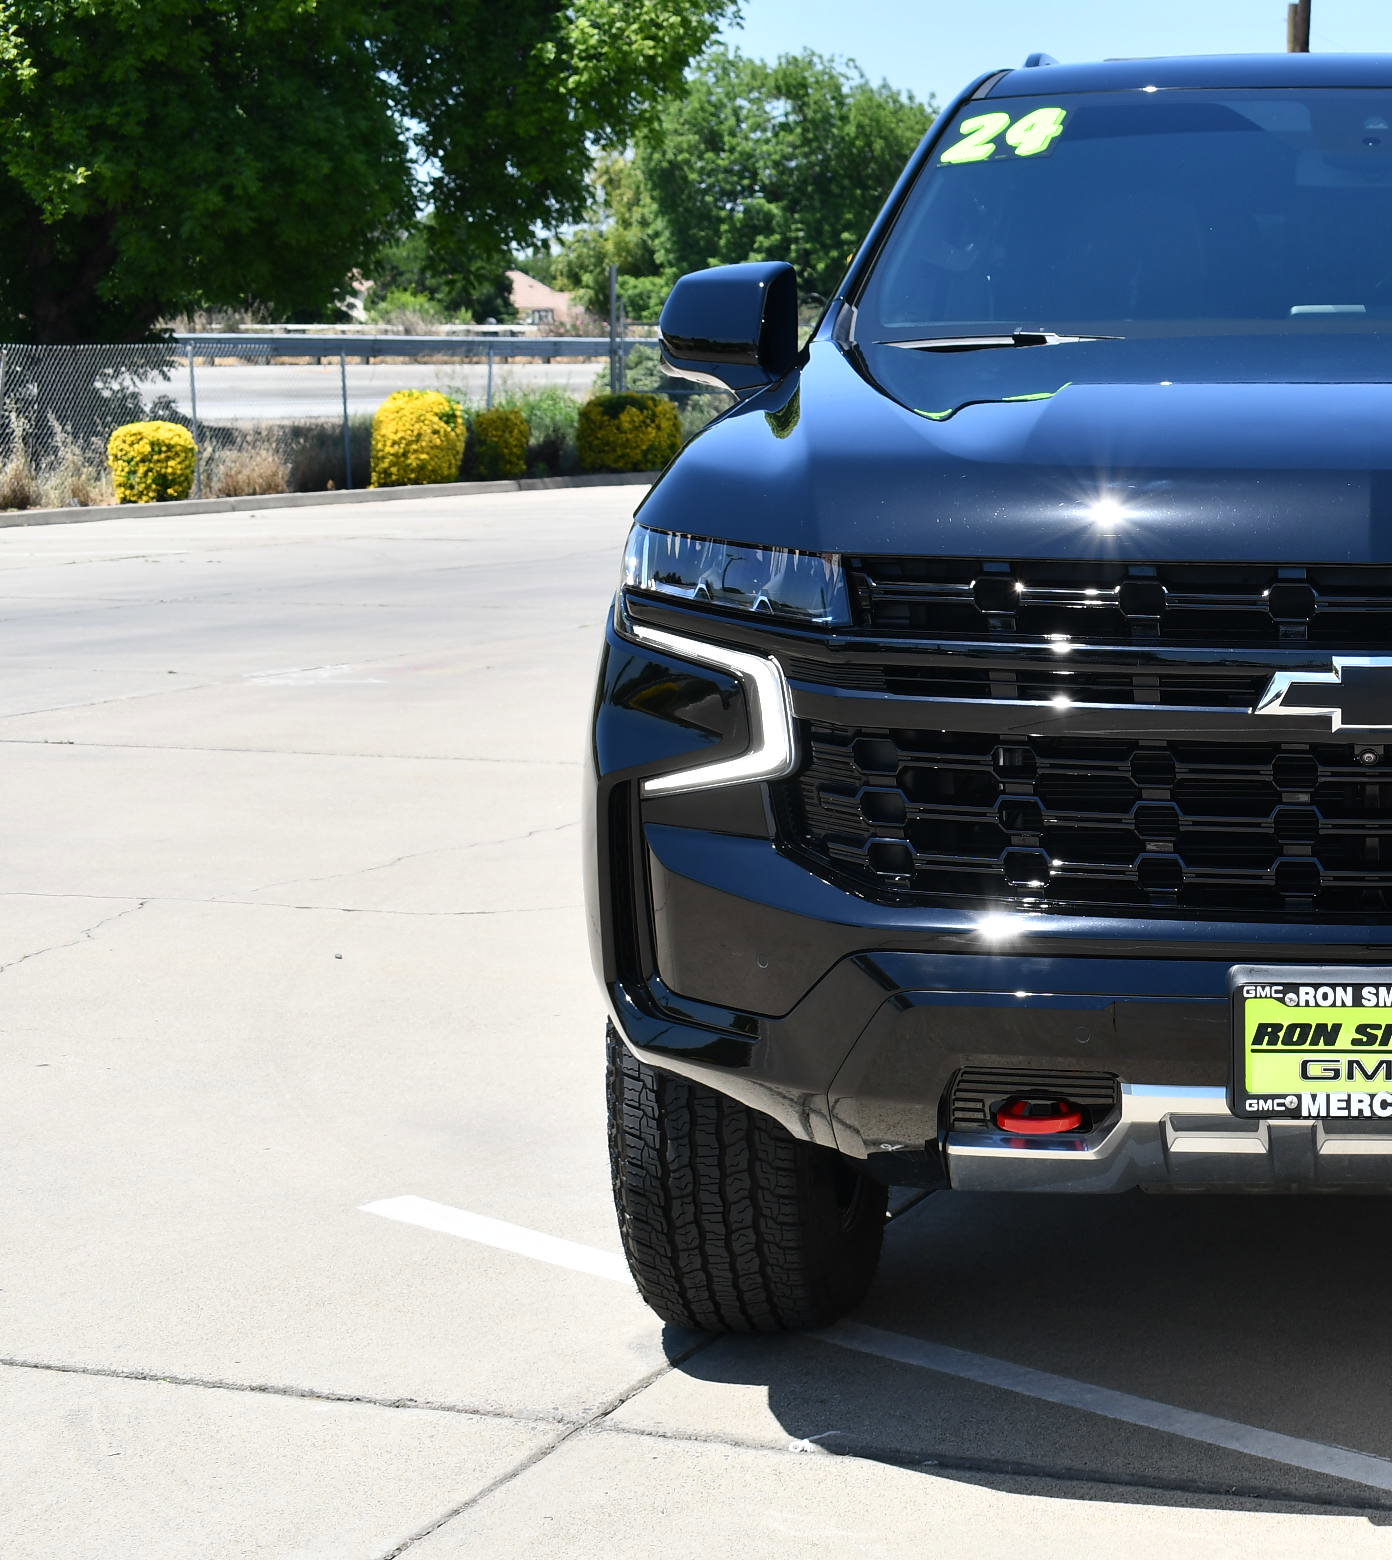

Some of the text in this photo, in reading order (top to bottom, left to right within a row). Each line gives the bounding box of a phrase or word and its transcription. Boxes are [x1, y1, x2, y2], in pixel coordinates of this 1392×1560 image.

[940, 107, 1067, 163] 24
[1243, 985, 1284, 998] GMC
[1298, 986, 1353, 1007] RON
[1251, 1022, 1343, 1047] RON
[1245, 1099, 1286, 1111] GMC
